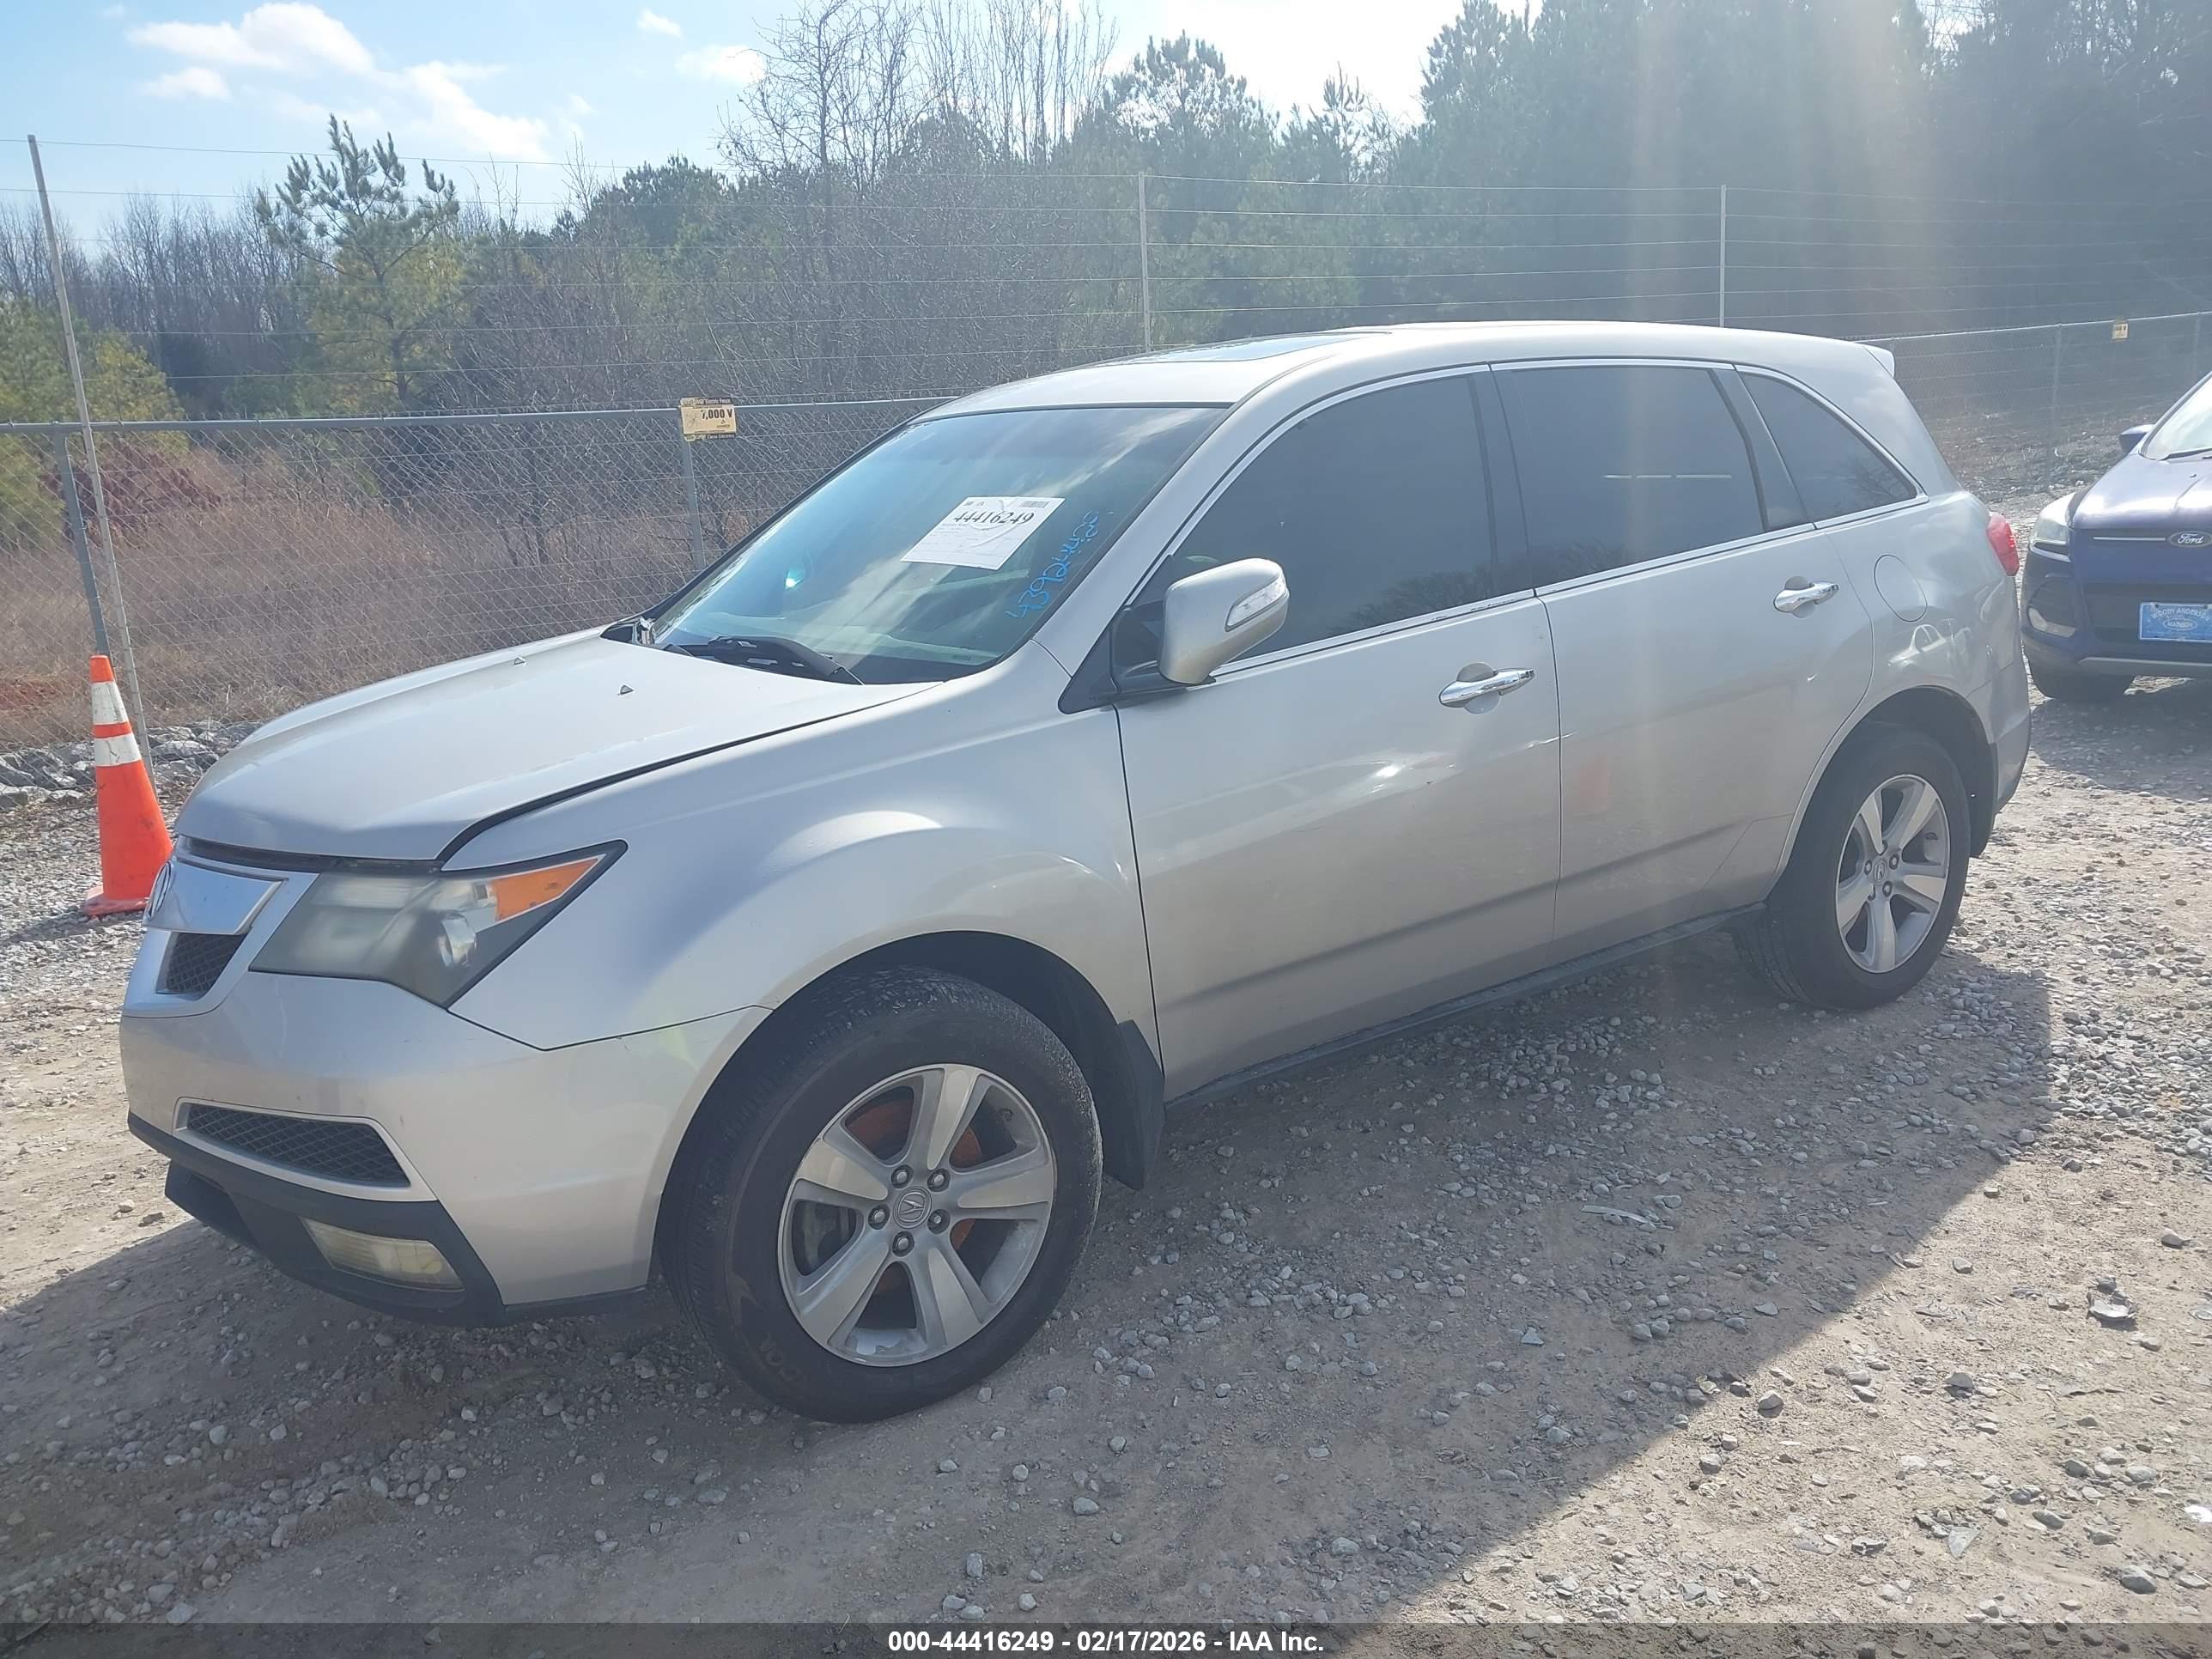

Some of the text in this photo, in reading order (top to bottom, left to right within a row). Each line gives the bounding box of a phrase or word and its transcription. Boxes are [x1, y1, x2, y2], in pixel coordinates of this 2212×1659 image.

[701, 409, 732, 420] 7,000 V
[954, 511, 1034, 526] 44416249
[2178, 533, 2204, 544] Ford
